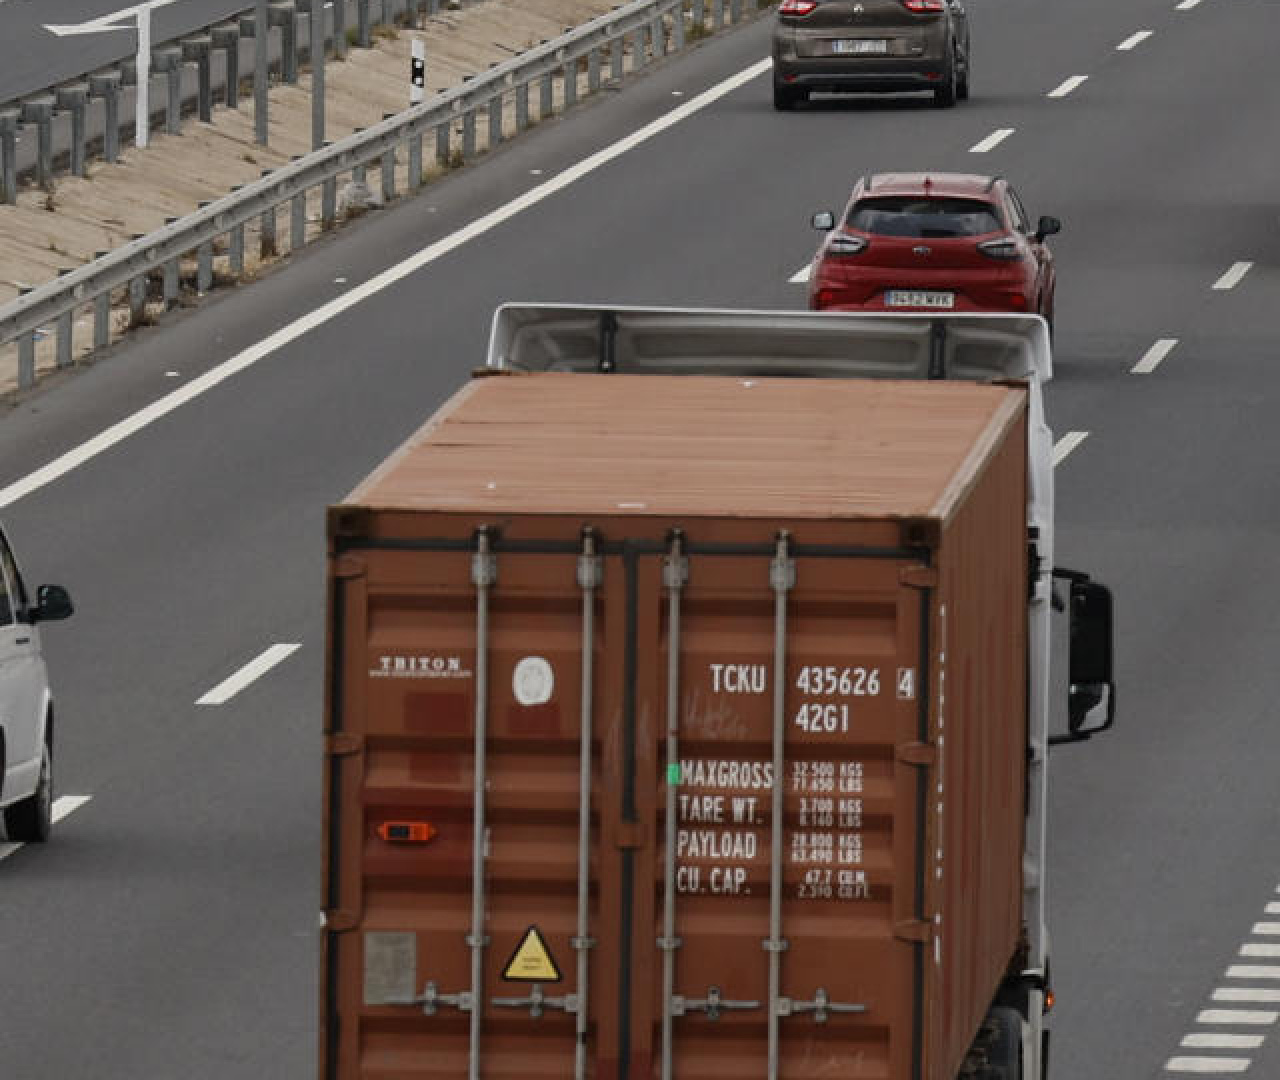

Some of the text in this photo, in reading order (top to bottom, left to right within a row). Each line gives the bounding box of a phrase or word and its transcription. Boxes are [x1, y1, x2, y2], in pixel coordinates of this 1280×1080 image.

[379, 655, 461, 671] TRITON
[710, 664, 915, 698] TCKU 435626 4
[795, 704, 850, 733] 42G1
[680, 760, 774, 789] MAXGROSS
[680, 796, 725, 823] TARE
[731, 797, 764, 825] WT.
[677, 830, 757, 860] PAYLOAD
[677, 866, 706, 895] CU.
[710, 868, 752, 896] CAP.
